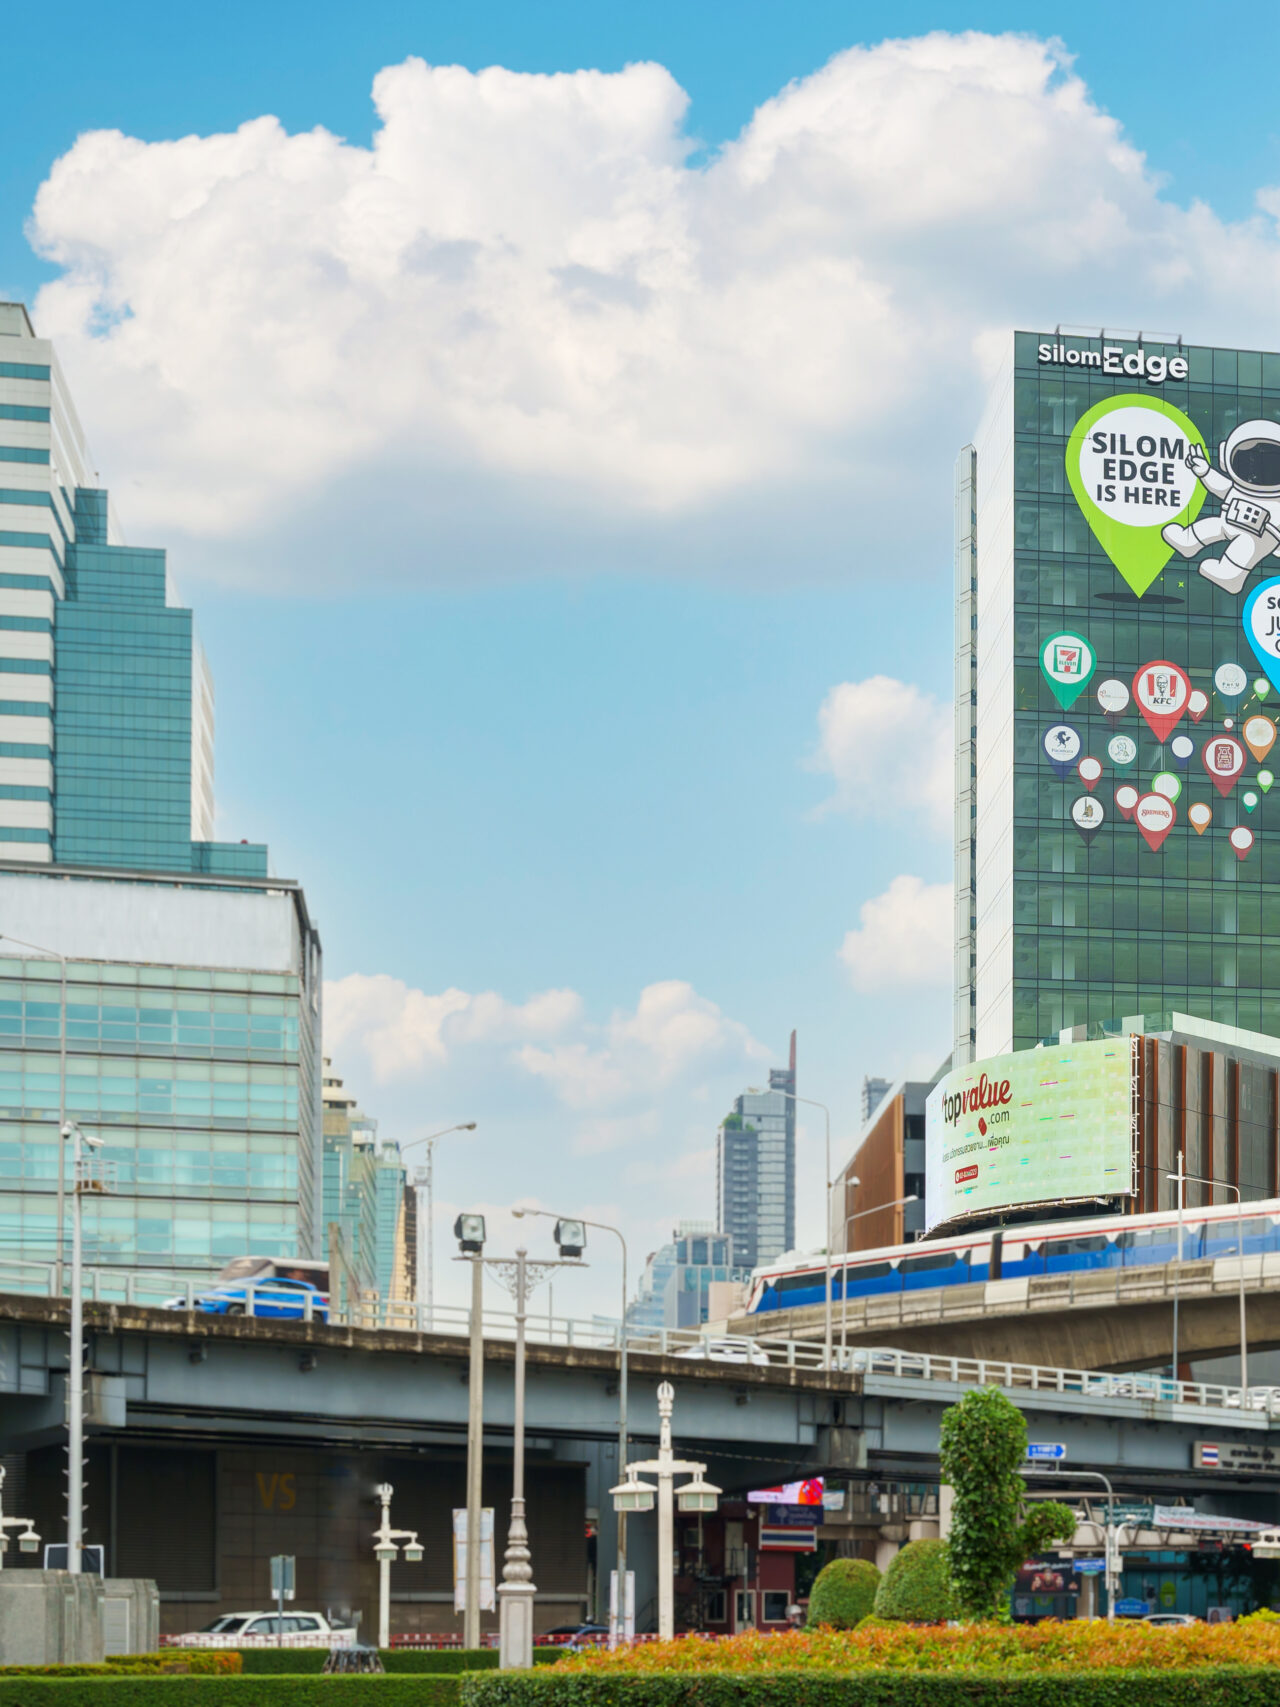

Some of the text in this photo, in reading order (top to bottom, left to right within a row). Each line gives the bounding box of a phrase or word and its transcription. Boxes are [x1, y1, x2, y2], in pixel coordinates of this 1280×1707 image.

[1092, 432, 1184, 460] SILOM
[1103, 458, 1175, 485] EDGE
[1097, 484, 1181, 507] IS HERE
[1152, 697, 1173, 705] KFC
[942, 1073, 1013, 1127] topvalue
[255, 1472, 296, 1511] VS
